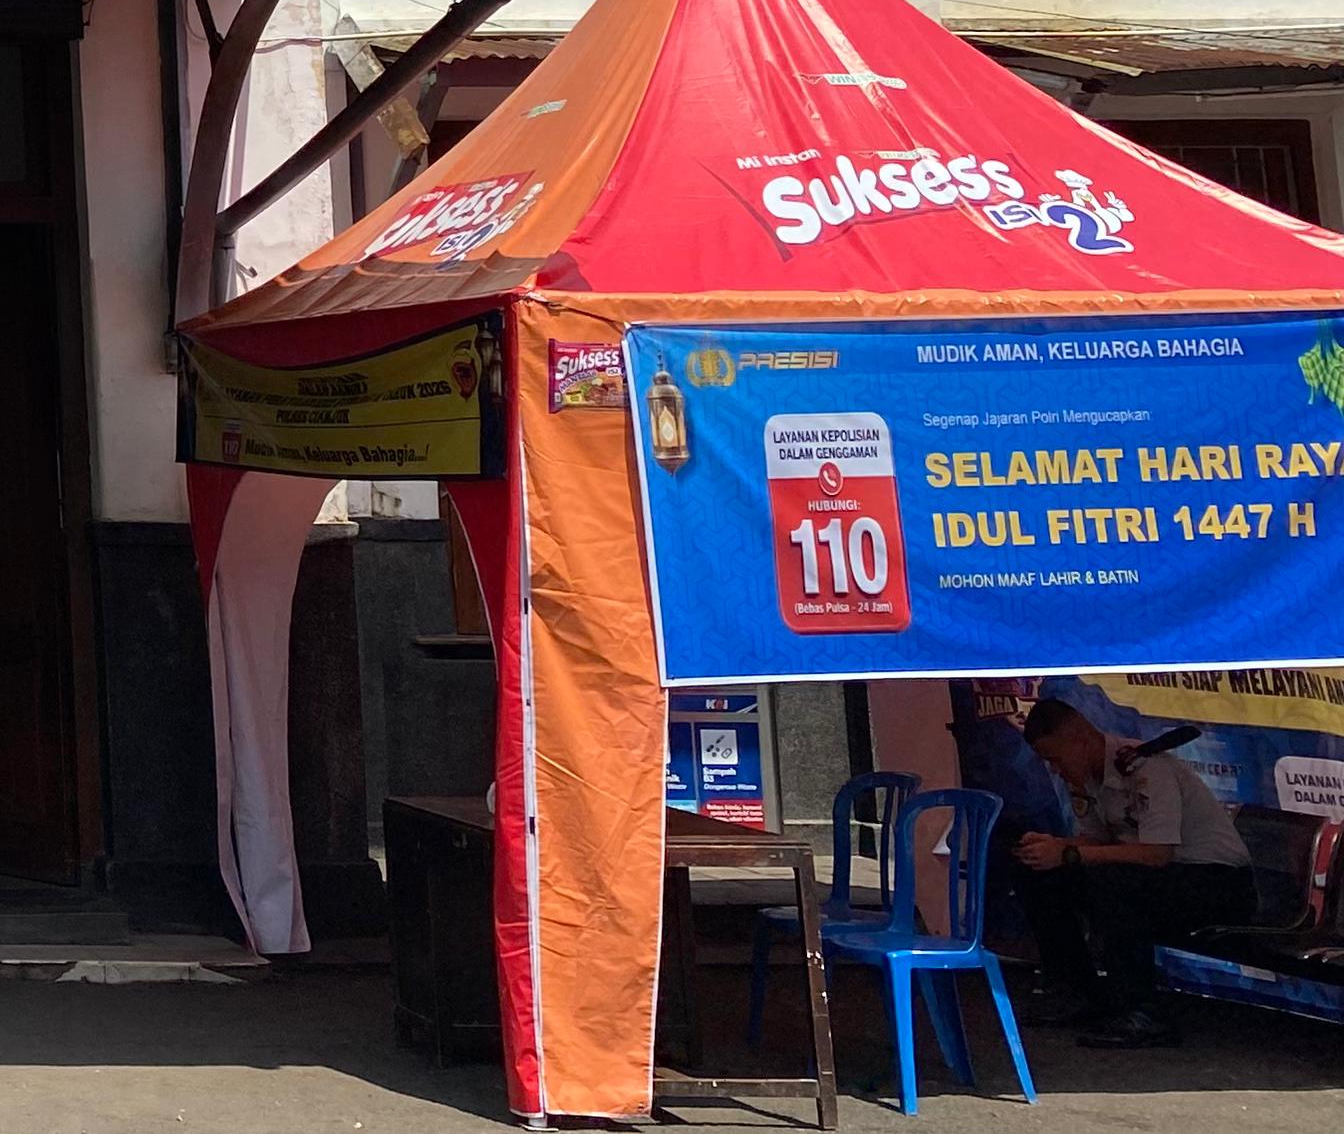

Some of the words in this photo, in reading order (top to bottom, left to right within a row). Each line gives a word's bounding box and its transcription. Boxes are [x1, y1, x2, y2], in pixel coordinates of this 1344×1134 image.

[736, 155, 762, 170] Mi
[763, 148, 823, 167] Instan
[989, 204, 1043, 225] ISI
[1047, 204, 1128, 251] 2
[917, 344, 979, 363] MUDIK
[983, 342, 1044, 363] AMAN,
[1048, 339, 1154, 360] KELUARGA
[1157, 337, 1244, 357] BAHAGIA
[737, 351, 840, 371] PRESISI
[923, 413, 979, 429] Segenap
[982, 411, 1028, 428] Jajaran
[1032, 410, 1059, 424] Polri
[773, 430, 819, 444] LAYANAN
[822, 428, 880, 442] KEPOLISIAN
[779, 447, 814, 460] DALAM
[817, 446, 878, 459] GENGGAMAN
[925, 448, 1124, 488] SELAMAT
[1137, 444, 1243, 482] HARI
[1256, 441, 1344, 479] RAY
[808, 500, 861, 511] HUBUNGI:
[933, 510, 1036, 548] IDUL
[1047, 506, 1160, 545] FITRI
[1173, 503, 1274, 541] 1447
[1288, 502, 1317, 538] H
[790, 516, 889, 595] 110
[940, 573, 994, 589] MOHON
[998, 571, 1038, 586] MAAF
[1040, 570, 1082, 585] LAHIR
[1085, 570, 1095, 584] &
[1098, 569, 1139, 584] BATIN
[794, 602, 824, 615] (Bebas
[826, 602, 849, 613] Pulsa
[858, 601, 870, 612] 24
[871, 601, 893, 614] Jam)
[1182, 670, 1223, 693] SIAP
[1228, 668, 1326, 702] MELAYANI
[1285, 772, 1341, 789] LAYANAN
[1294, 791, 1337, 805] DALAM
